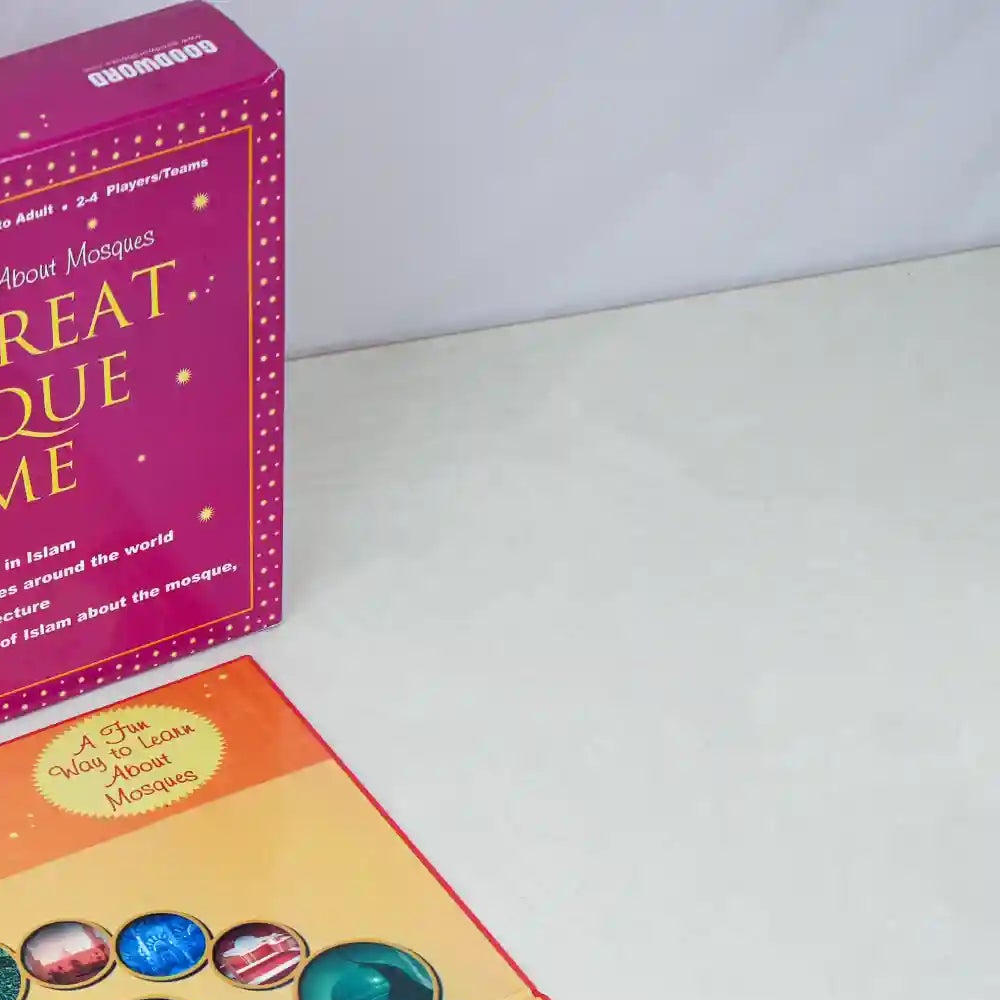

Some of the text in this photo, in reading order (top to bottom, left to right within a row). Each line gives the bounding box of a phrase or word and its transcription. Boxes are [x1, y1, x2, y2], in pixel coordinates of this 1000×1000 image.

[87, 39, 219, 88] GOODWORD
[15, 204, 54, 226] Adult
[76, 191, 99, 209] 2-4
[106, 157, 209, 197] Players/Teams
[66, 229, 156, 267] Mosques
[4, 558, 21, 571] in
[26, 539, 77, 564] Islam
[23, 559, 85, 590] around
[90, 550, 119, 568] the
[124, 529, 174, 557] world
[0, 632, 18, 648] of
[23, 616, 72, 641] Islam
[77, 595, 127, 623] about
[131, 586, 160, 604] the
[165, 562, 238, 593] mosque,
[48, 723, 196, 780] Way to Learn
[73, 720, 151, 757] A Fun
[105, 753, 173, 788] About
[105, 769, 198, 812] Mosques
